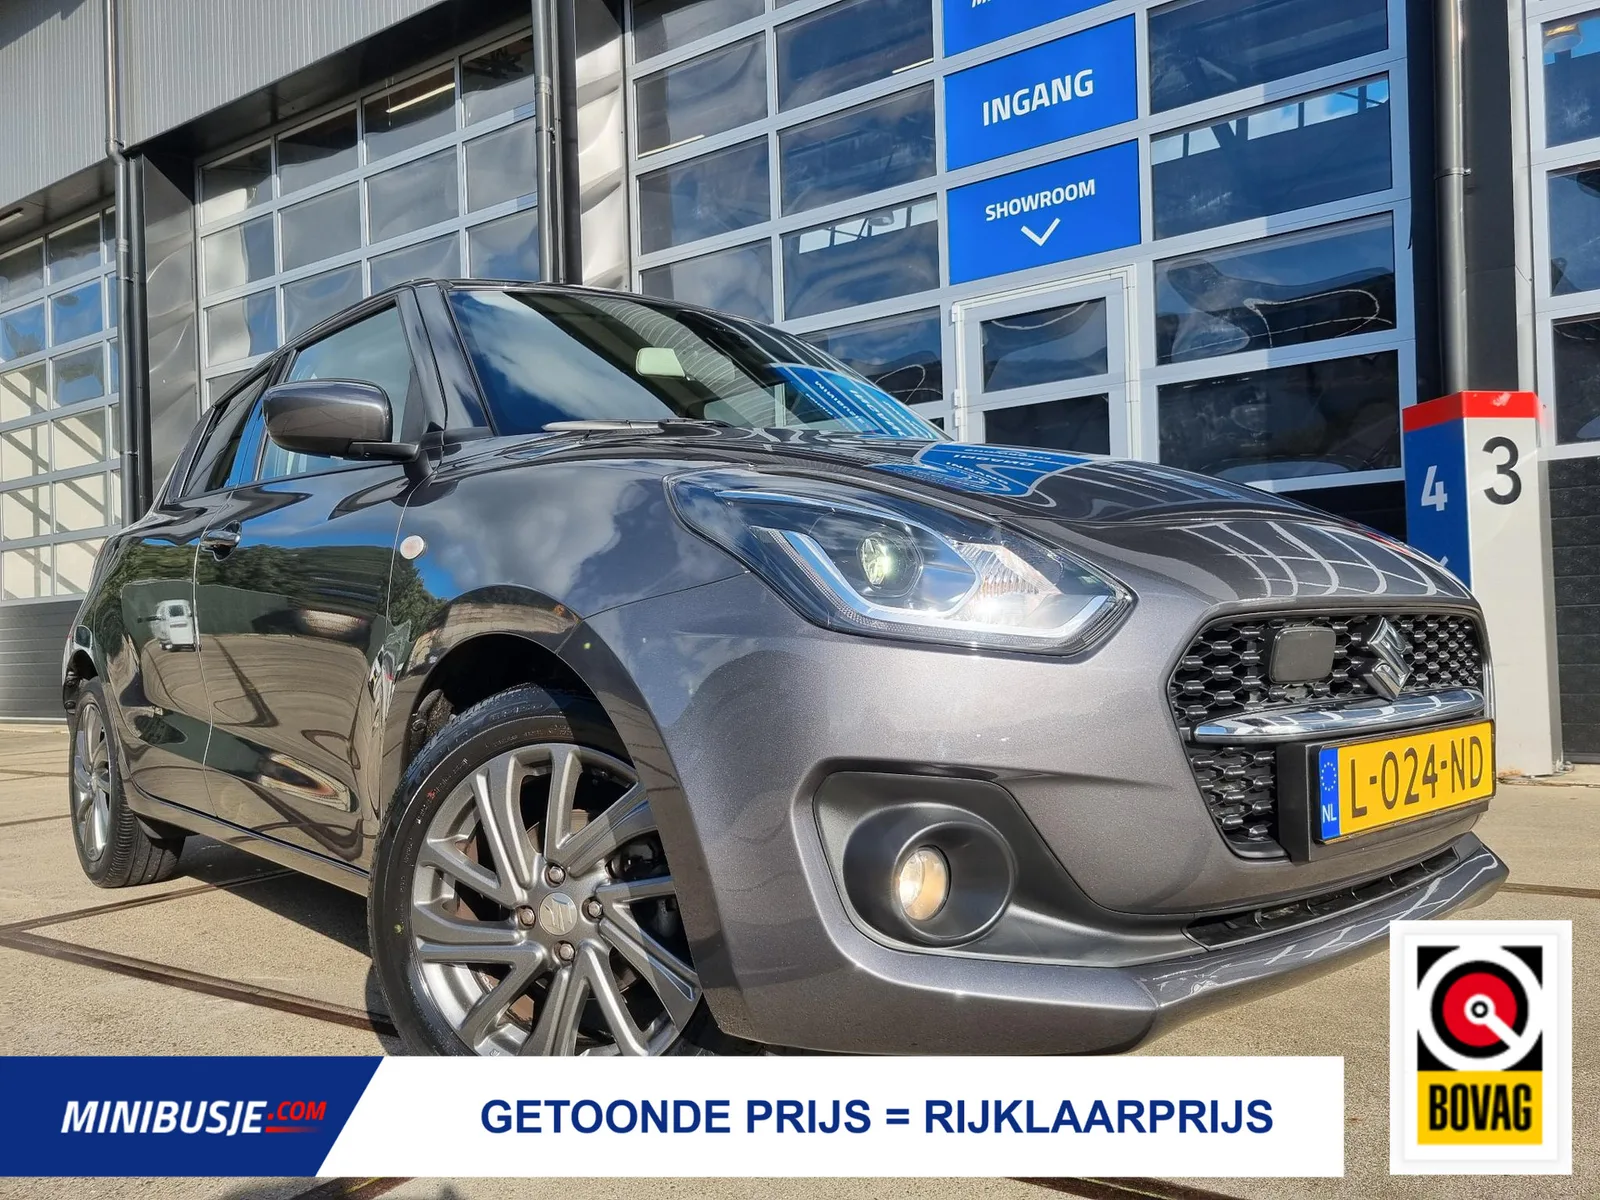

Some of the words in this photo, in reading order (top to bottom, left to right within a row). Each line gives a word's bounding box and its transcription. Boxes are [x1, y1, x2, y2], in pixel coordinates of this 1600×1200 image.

[982, 69, 1094, 126] INGANG
[985, 179, 1096, 222] SHOWROOM
[1421, 465, 1448, 511] 4
[1481, 436, 1522, 505] 3
[1350, 736, 1484, 819] L-024-ND
[1322, 803, 1337, 823] NL
